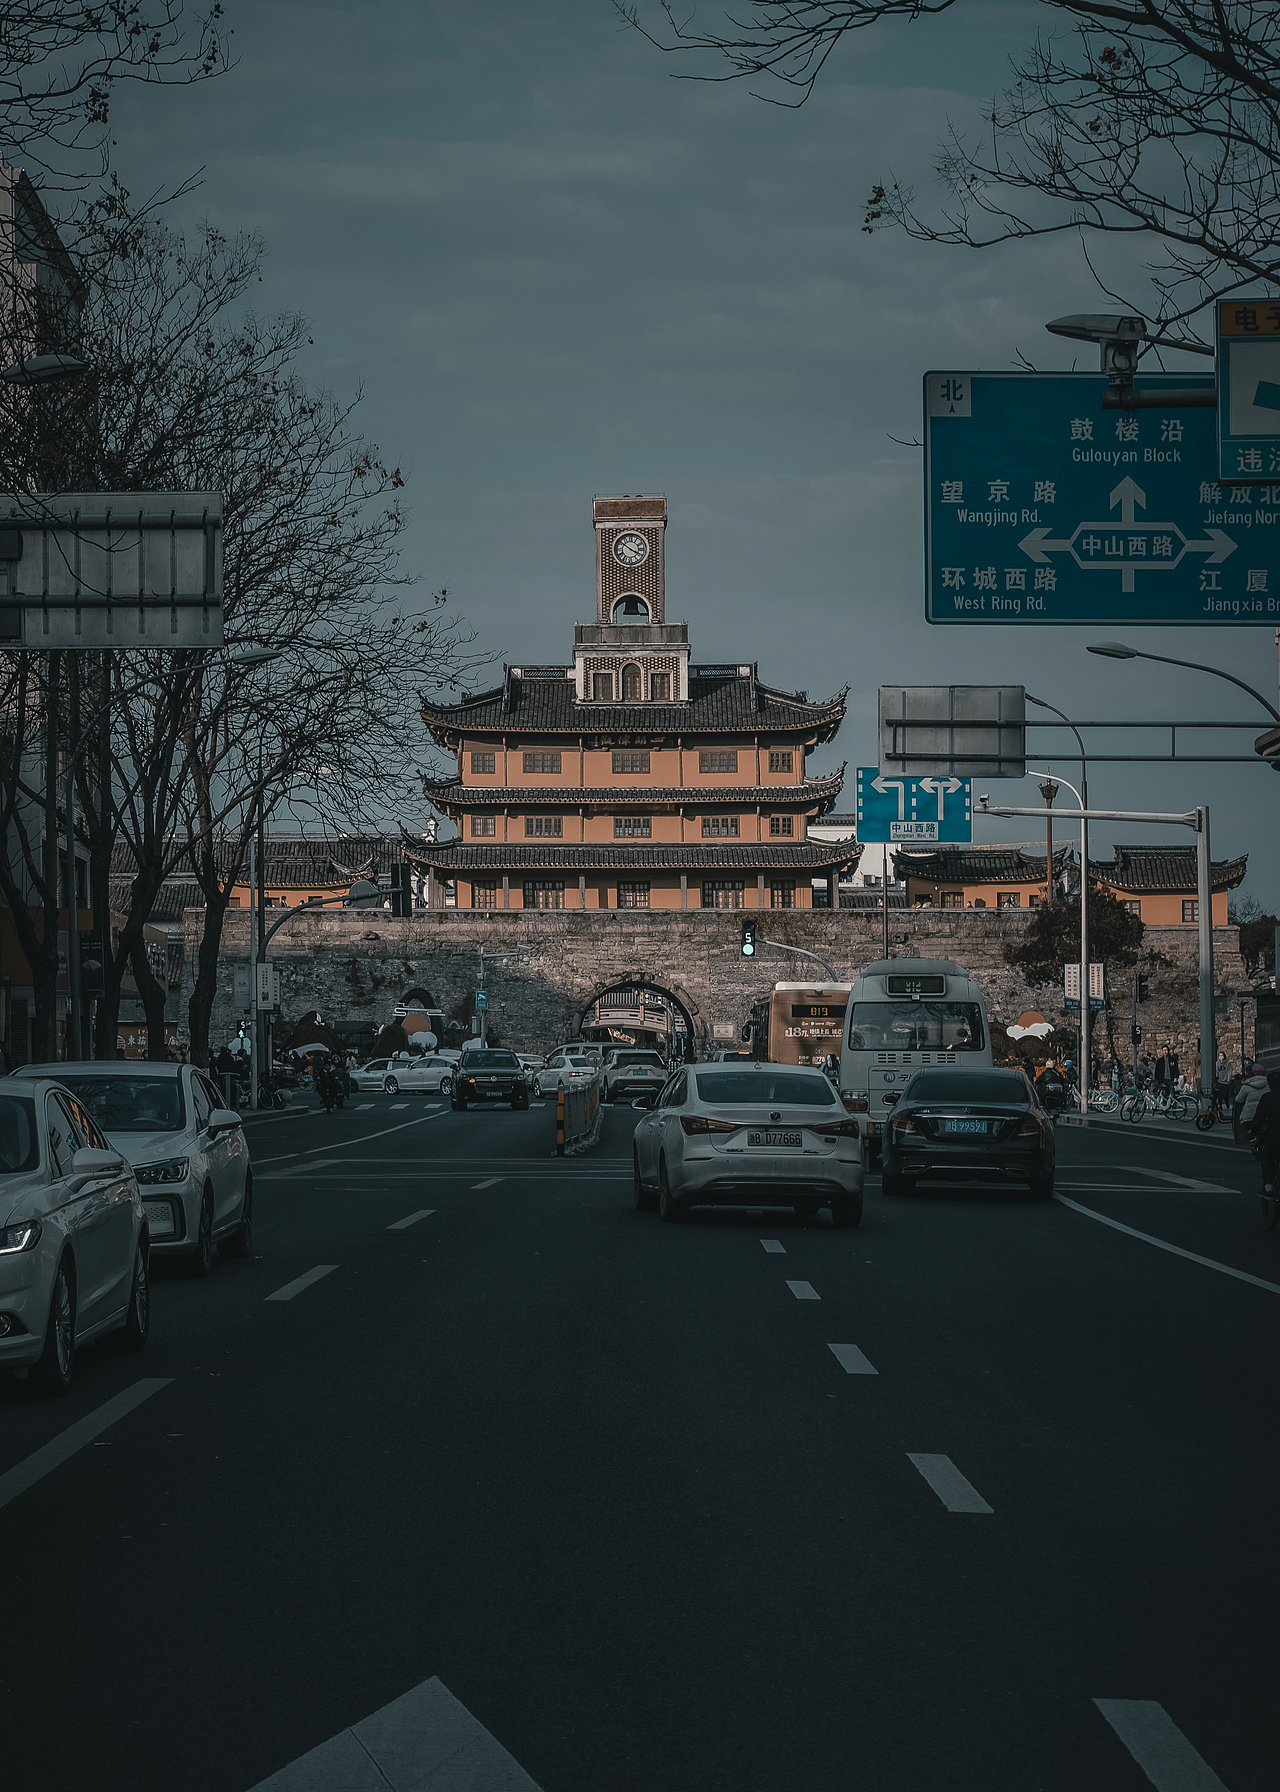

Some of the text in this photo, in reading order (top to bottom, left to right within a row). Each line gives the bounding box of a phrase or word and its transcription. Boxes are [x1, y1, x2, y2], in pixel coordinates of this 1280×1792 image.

[941, 379, 963, 401] 北
[1070, 418, 1184, 442] 鼓楼沿
[1072, 448, 1182, 466] Gulouyan Block
[941, 479, 1057, 503] 望京路
[957, 509, 1042, 526] Wangjing Rd.
[1203, 510, 1252, 528] Jiefang
[1082, 535, 1173, 556] 中山西路
[941, 566, 1057, 590] 环城西路
[1199, 569, 1269, 592] 江厦
[954, 596, 1047, 614] West Ring Rd.
[1203, 597, 1263, 615] Jiangxia
[892, 823, 935, 833] 中山西路
